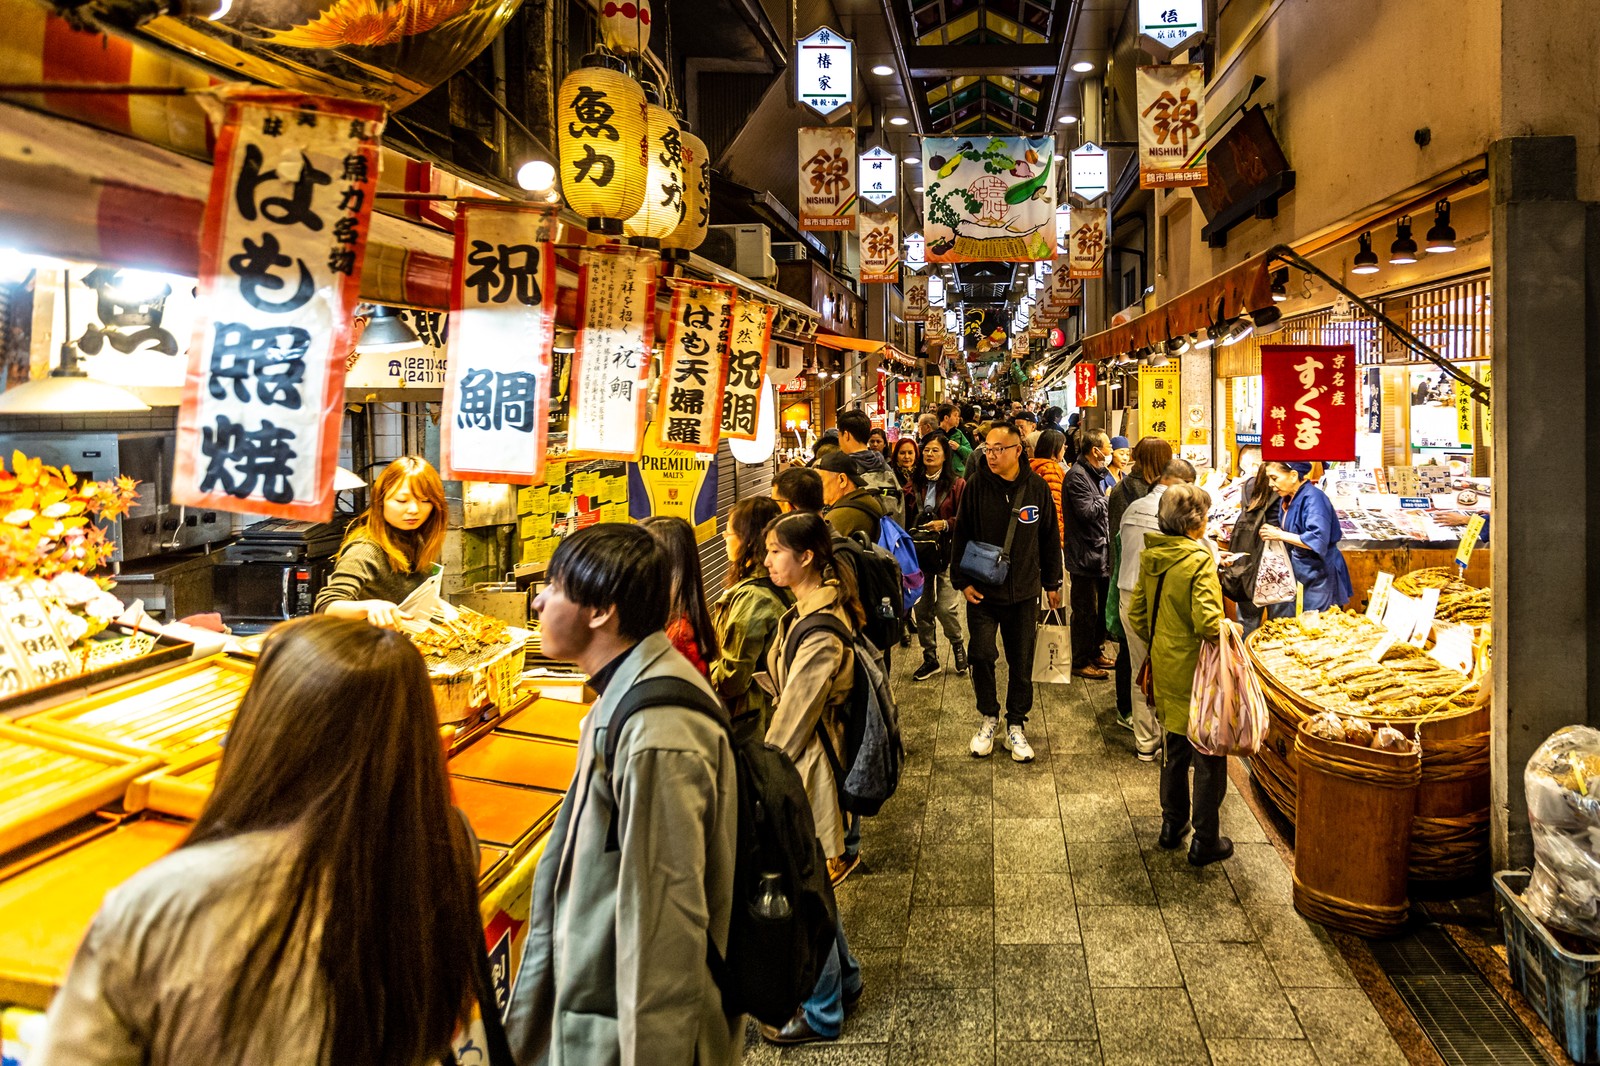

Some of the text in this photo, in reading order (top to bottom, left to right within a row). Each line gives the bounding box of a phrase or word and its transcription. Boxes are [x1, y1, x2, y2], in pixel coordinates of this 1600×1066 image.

[1157, 29, 1188, 39] 京漬物
[817, 53, 832, 90] 椿家
[569, 86, 620, 187] 魚力
[1142, 87, 1201, 158] 錦
[1149, 147, 1182, 156] NISHIKI
[802, 147, 850, 206] 錦
[1146, 171, 1202, 183] 錦市場商店街
[327, 154, 369, 276] 魚力名物
[806, 196, 836, 204] NISHIKI
[803, 217, 850, 226] 錦市場商店街
[862, 226, 895, 266] 錦
[1072, 222, 1103, 262] 錦
[905, 284, 927, 312] 錦
[457, 239, 542, 433] 祝鯛
[737, 310, 755, 345] 天然
[609, 345, 637, 402] 祝鯛
[667, 303, 715, 444] はも天婦羅
[721, 349, 763, 435] 祝鯛
[1331, 354, 1346, 407] 京名産
[1293, 355, 1328, 450] すぐき
[641, 455, 705, 471] PREMIUM
